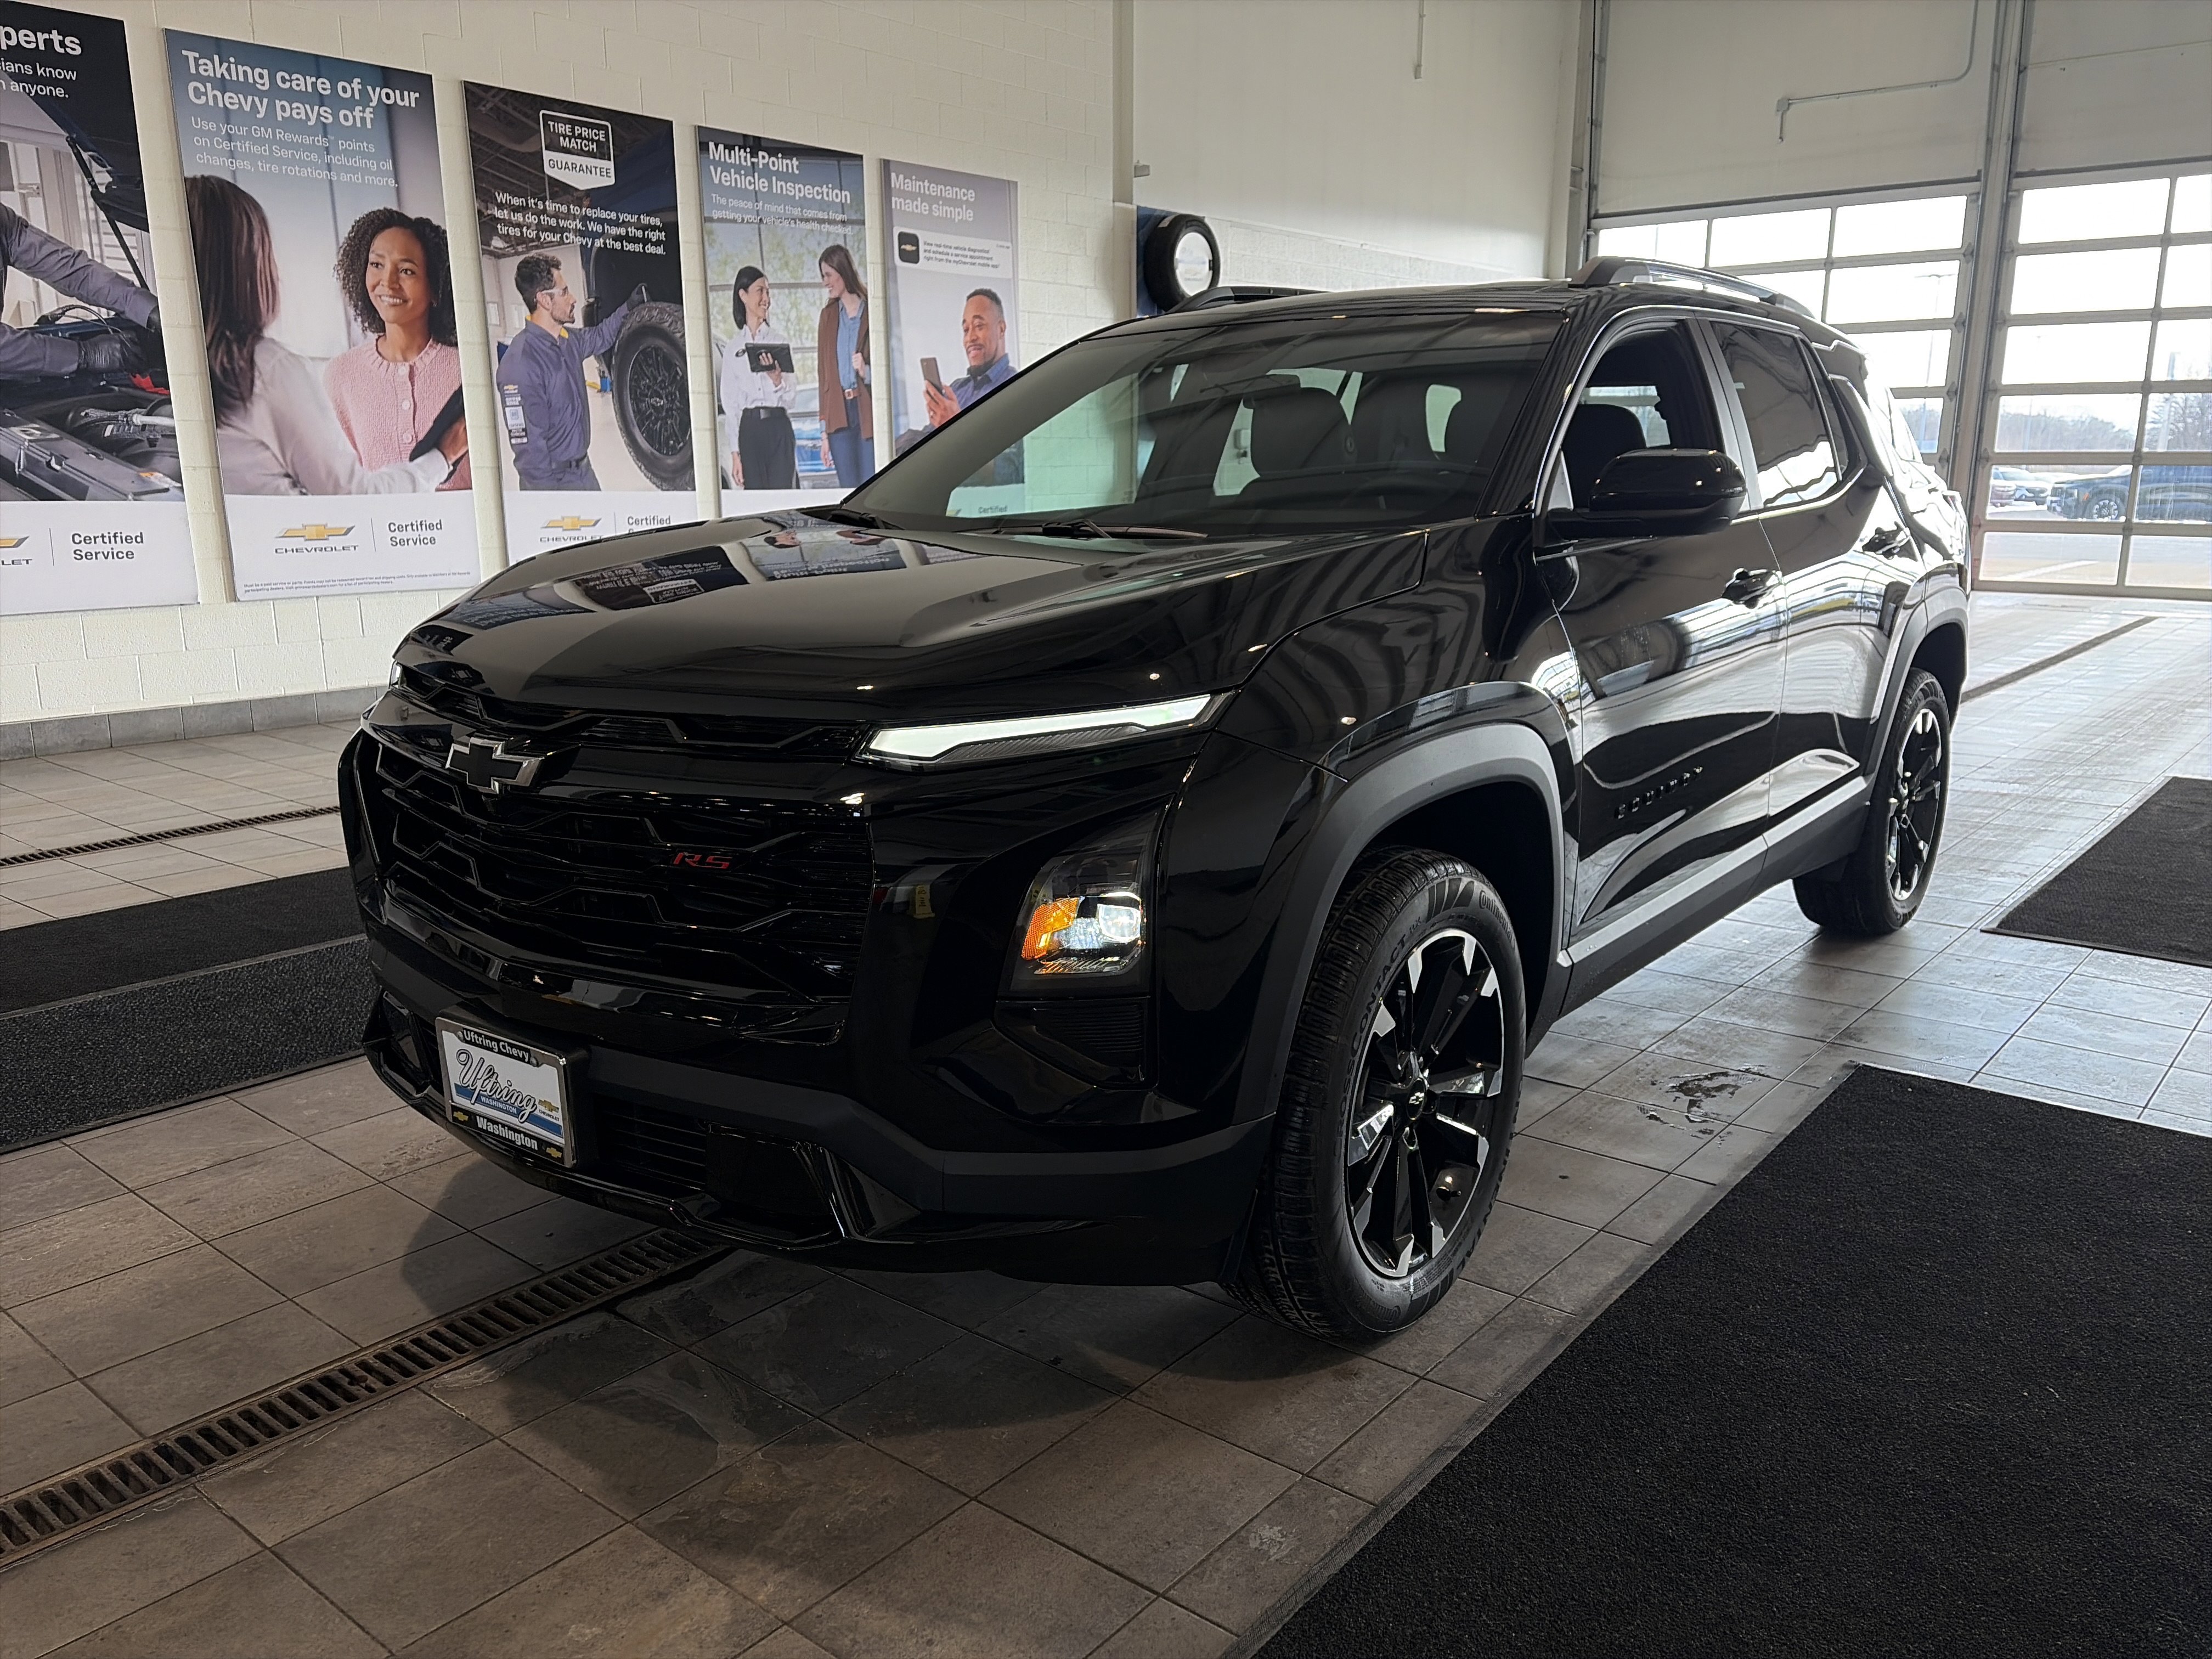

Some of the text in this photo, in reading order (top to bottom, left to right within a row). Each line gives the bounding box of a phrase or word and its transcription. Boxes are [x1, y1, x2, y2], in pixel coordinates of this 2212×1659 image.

[0, 25, 82, 55] perts
[0, 58, 77, 81] ians know
[182, 49, 420, 108] Taking care of your
[10, 81, 69, 98] anyone.
[188, 81, 374, 129] Chevy pays off
[191, 116, 216, 131] Use
[219, 123, 249, 136] your
[251, 126, 273, 139] GM
[339, 138, 375, 153] points
[548, 121, 606, 142] TIRE PRICE
[560, 136, 596, 153] MATCH
[194, 137, 393, 171] on Certified Service, including oil
[549, 158, 612, 178] GUARANTEE
[709, 141, 799, 174] Multi-Point
[196, 152, 398, 187] changes, tire rotations and more.
[709, 165, 850, 204] Vehicle Inspection
[890, 172, 975, 202] Maintenance
[495, 191, 526, 207] When
[545, 200, 568, 213] time
[570, 204, 580, 215] to
[582, 206, 617, 219] replace
[618, 212, 639, 223] your
[640, 213, 663, 228] tires,
[711, 193, 848, 222] The peace of mind that comes from
[712, 210, 742, 223] getting
[743, 214, 761, 223] your
[796, 218, 820, 231] health
[891, 196, 974, 223] made simple
[494, 206, 666, 242] let us do the work. We have the right
[496, 223, 666, 255] tires for your Chevy at the best deal.
[388, 519, 443, 533] Certified
[627, 515, 671, 526] Certified
[71, 532, 144, 545] Certified
[275, 544, 359, 554] CHEVROLET
[390, 534, 436, 546] Service
[73, 547, 134, 561] Service
[673, 851, 733, 869] RS
[464, 1029, 530, 1063] Uftring Chevy
[456, 1048, 538, 1124] Uftring
[481, 1095, 517, 1115] WASHINGTON
[476, 1116, 538, 1151] Washington
